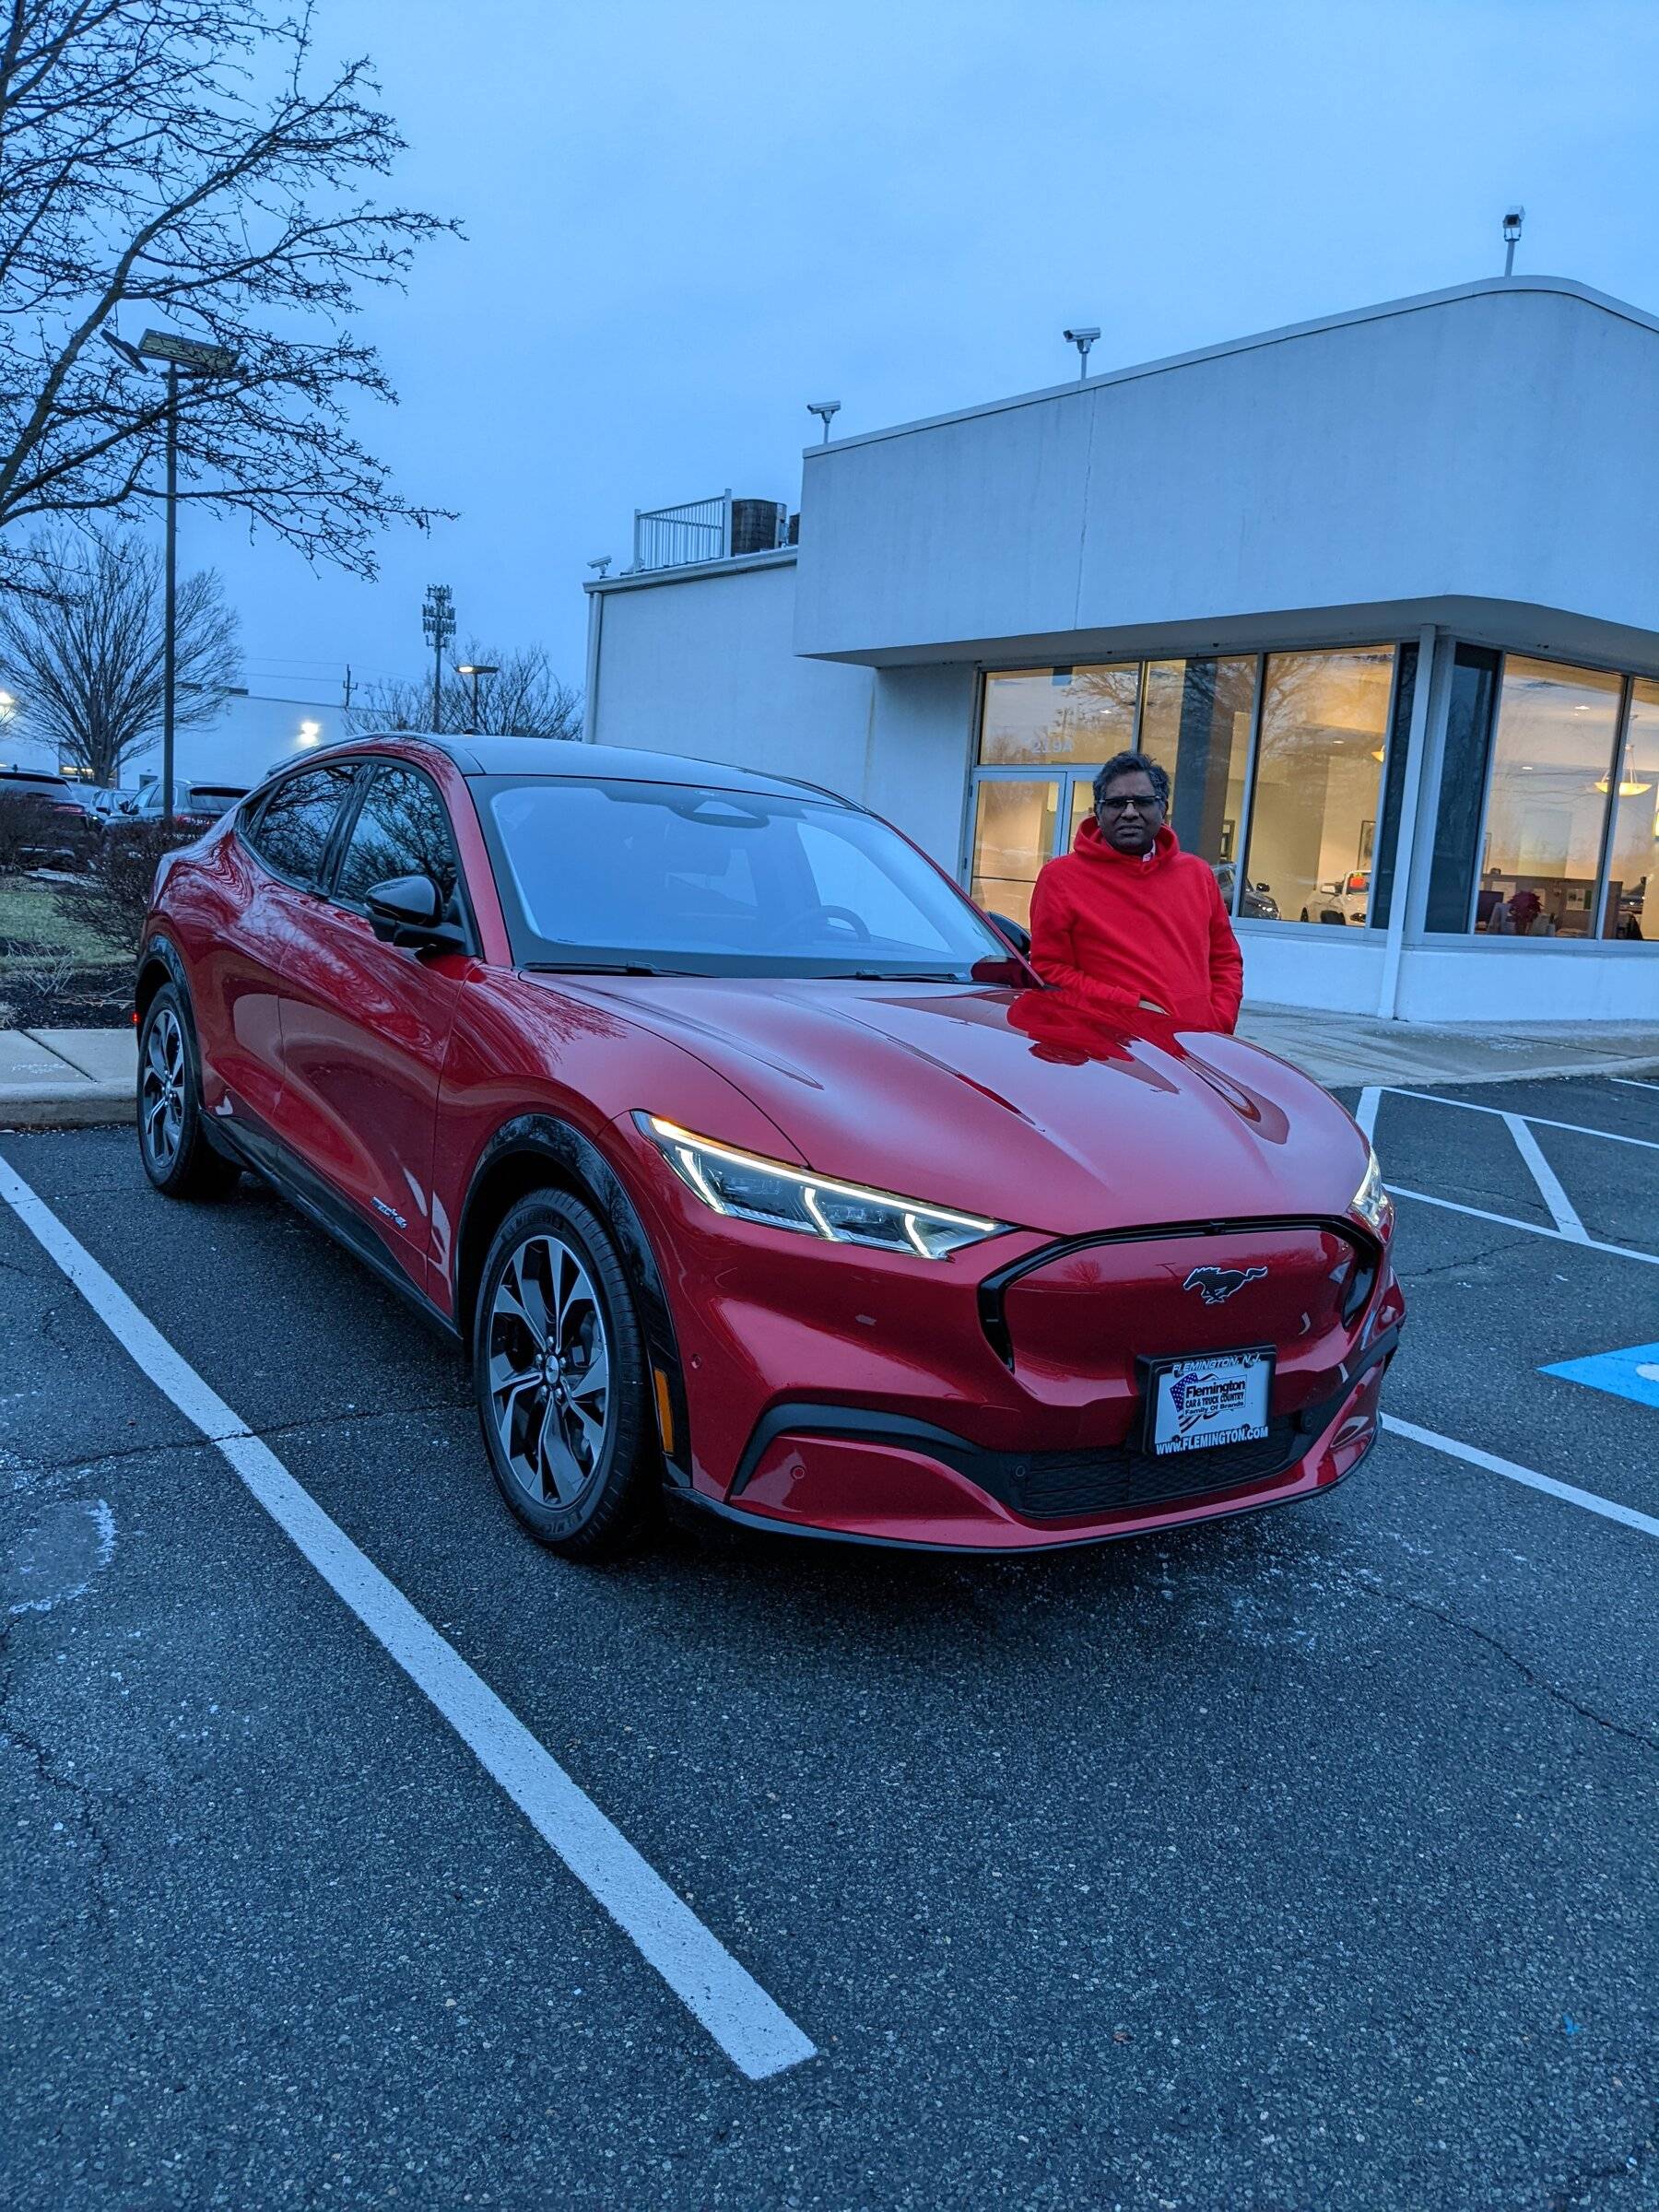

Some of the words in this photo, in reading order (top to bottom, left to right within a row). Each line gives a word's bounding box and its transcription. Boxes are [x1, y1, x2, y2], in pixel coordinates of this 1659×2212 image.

[1186, 1380, 1245, 1398] Flemington
[1185, 1398, 1196, 1408] CAR
[1197, 1399, 1201, 1407] &
[1202, 1395, 1218, 1406] TRUCK
[1220, 1392, 1244, 1403] COUNTRY
[1185, 1406, 1208, 1415] Family
[1220, 1401, 1244, 1409] Brands
[1156, 1427, 1268, 1455] WWW.FLEMINGTON.COM
